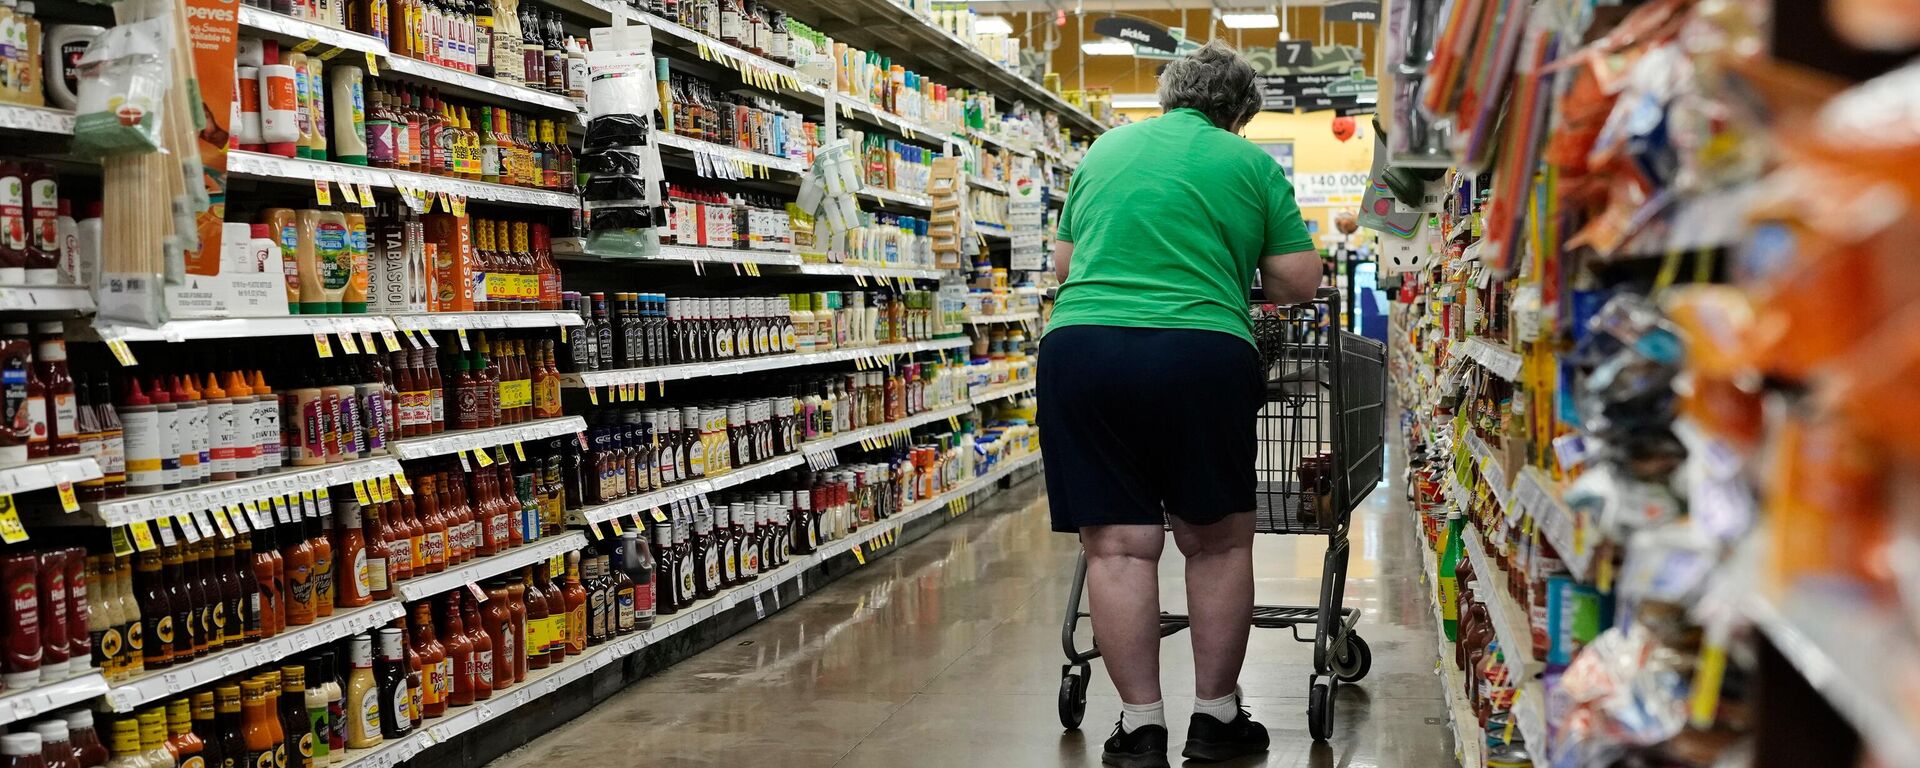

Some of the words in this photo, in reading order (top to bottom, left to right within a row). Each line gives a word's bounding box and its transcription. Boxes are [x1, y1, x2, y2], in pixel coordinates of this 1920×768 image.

[1352, 11, 1376, 20] pasta
[1120, 28, 1150, 42] pickles
[1286, 44, 1301, 63] 7
[386, 231, 404, 303] TABASCO
[461, 223, 472, 299] TABASCO
